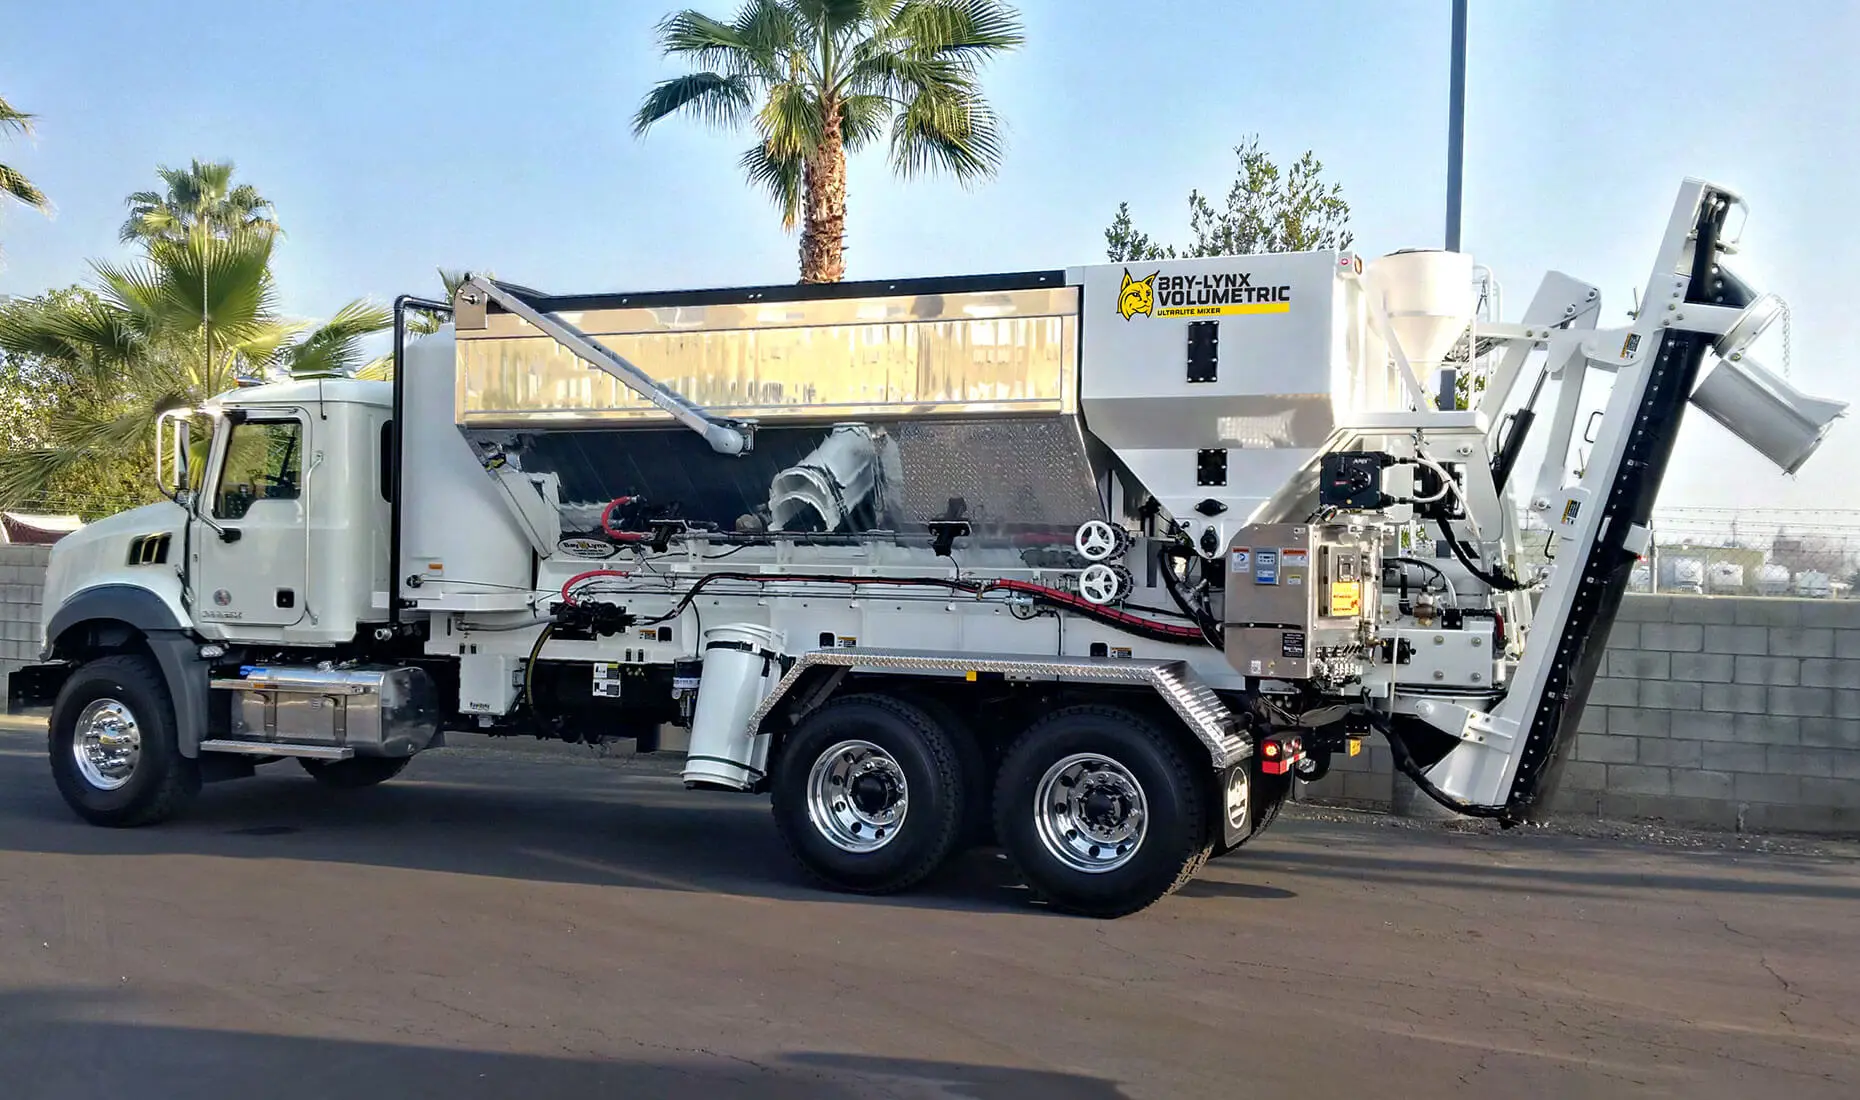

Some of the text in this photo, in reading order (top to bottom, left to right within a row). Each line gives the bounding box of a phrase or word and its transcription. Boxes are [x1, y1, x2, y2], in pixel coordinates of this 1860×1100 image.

[1158, 273, 1251, 290] BAY-LYNX
[1158, 286, 1290, 306] VOLUMETRIC
[1157, 308, 1195, 316] ULTRALITE
